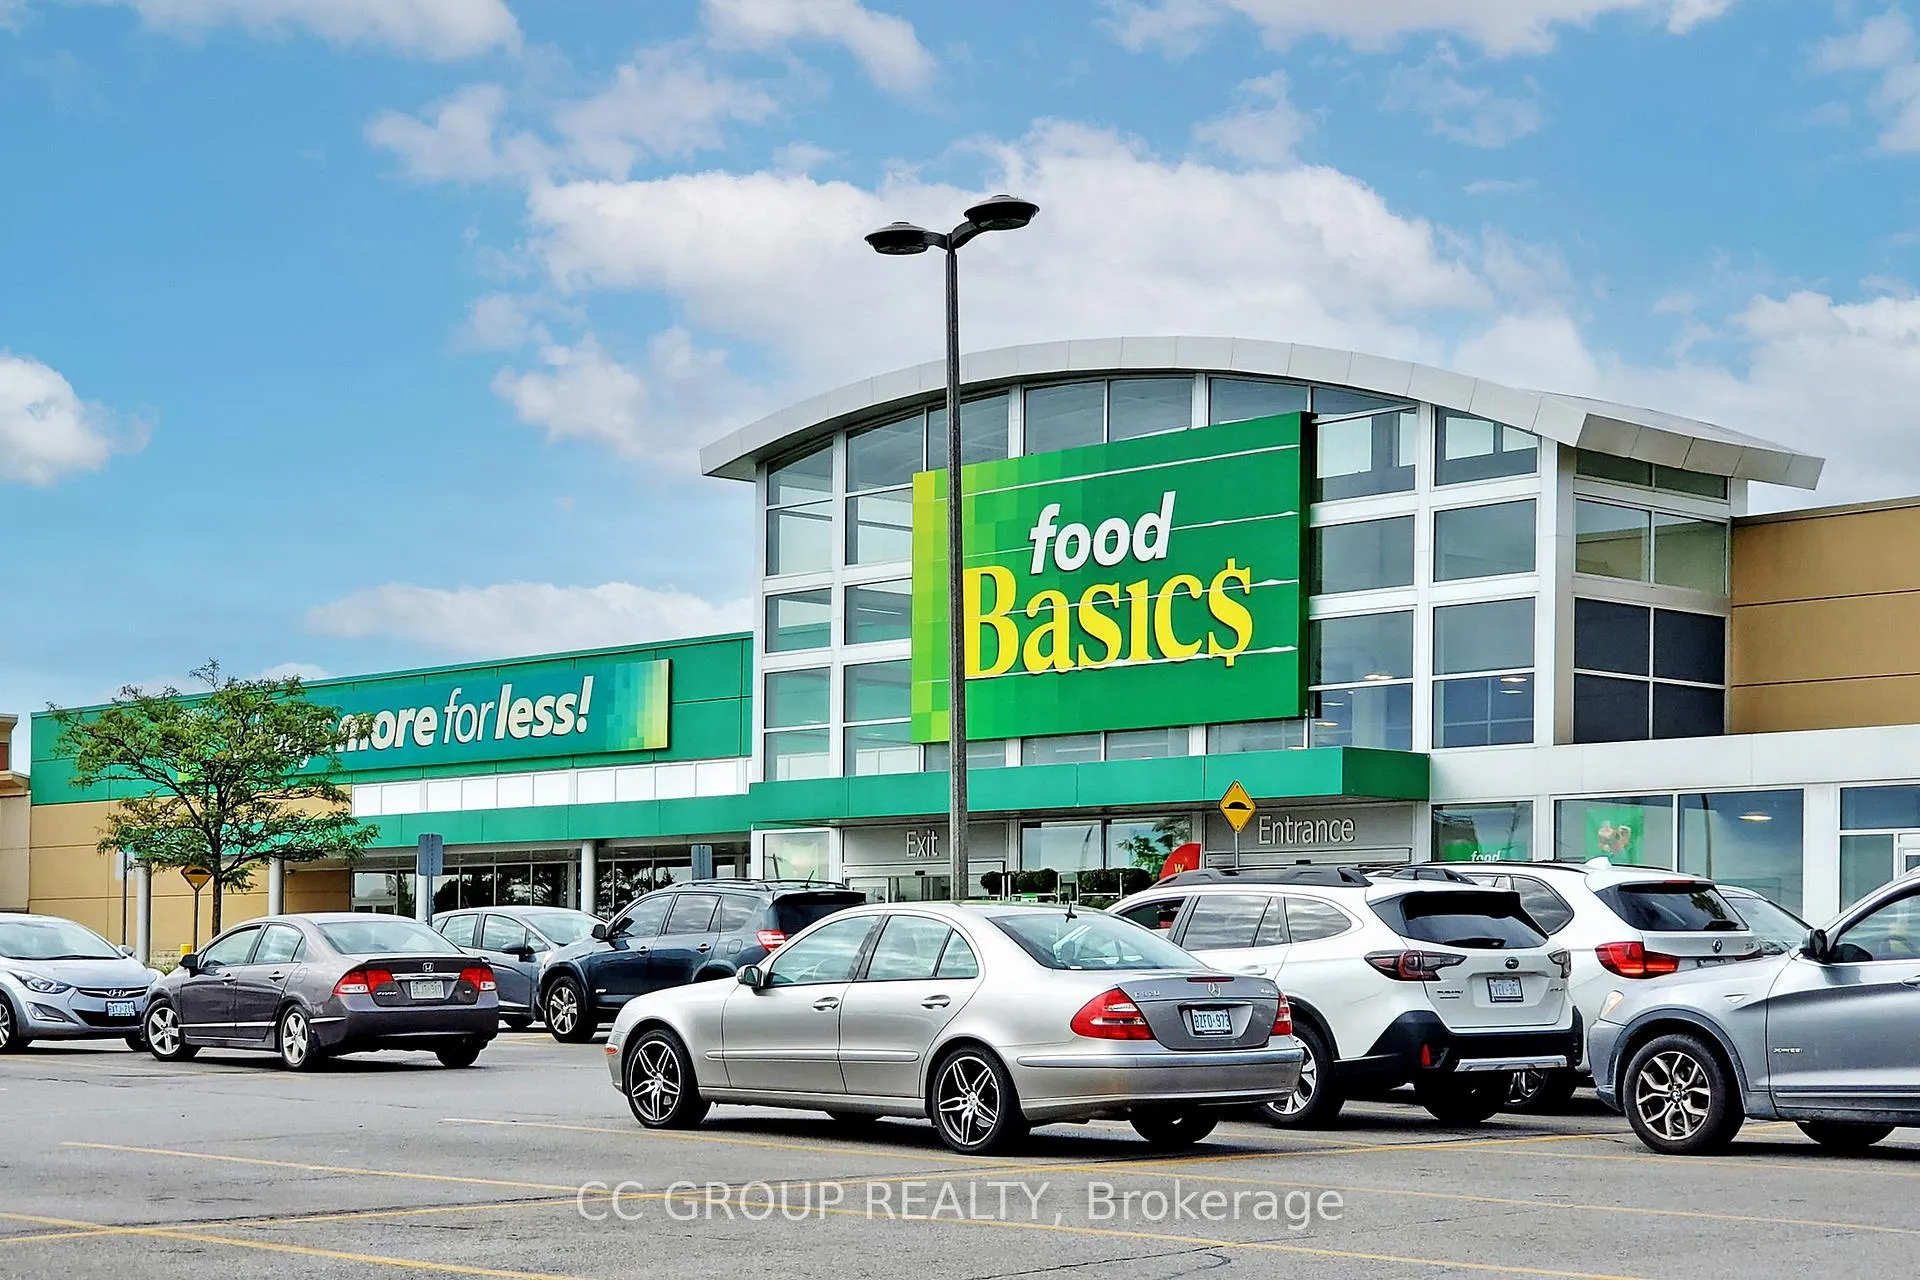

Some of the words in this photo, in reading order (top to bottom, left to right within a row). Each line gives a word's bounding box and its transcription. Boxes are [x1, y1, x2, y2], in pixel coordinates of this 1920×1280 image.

[1029, 490, 1176, 574] food
[442, 687, 496, 744] for
[494, 675, 594, 740] less!
[906, 830, 940, 857] Exit
[1258, 815, 1356, 845] Entrance
